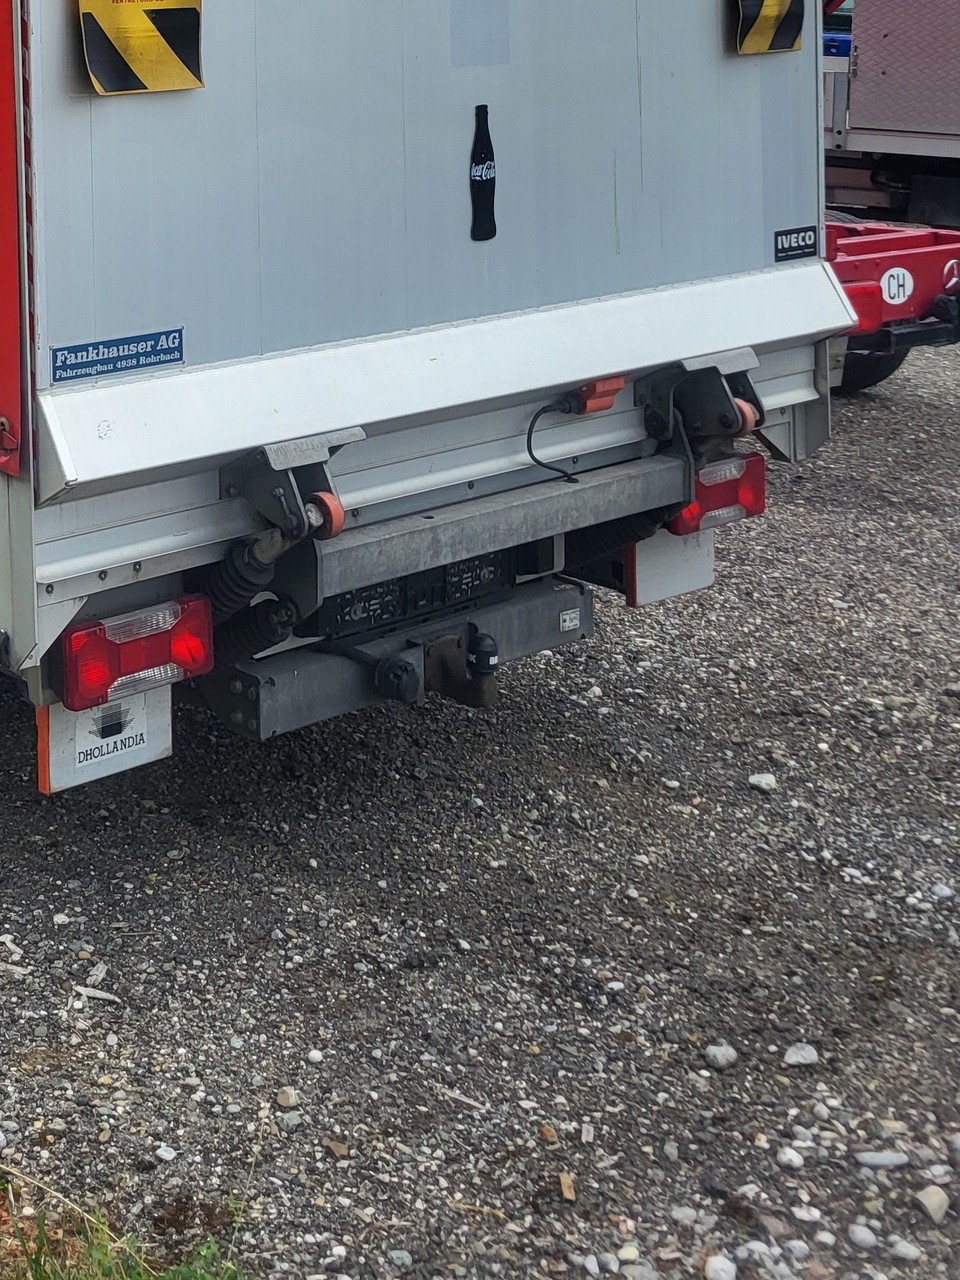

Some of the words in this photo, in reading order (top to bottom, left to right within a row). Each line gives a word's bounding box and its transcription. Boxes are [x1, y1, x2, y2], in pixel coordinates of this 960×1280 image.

[777, 231, 815, 250] IVECO
[887, 273, 906, 301] CH
[55, 340, 155, 367] Fankhauser
[156, 332, 181, 350] AG
[55, 362, 114, 379] Fahrzeugbau
[115, 358, 138, 370] 4938
[139, 351, 181, 366] Rohrbach
[77, 732, 146, 764] DHOLLANDIA
